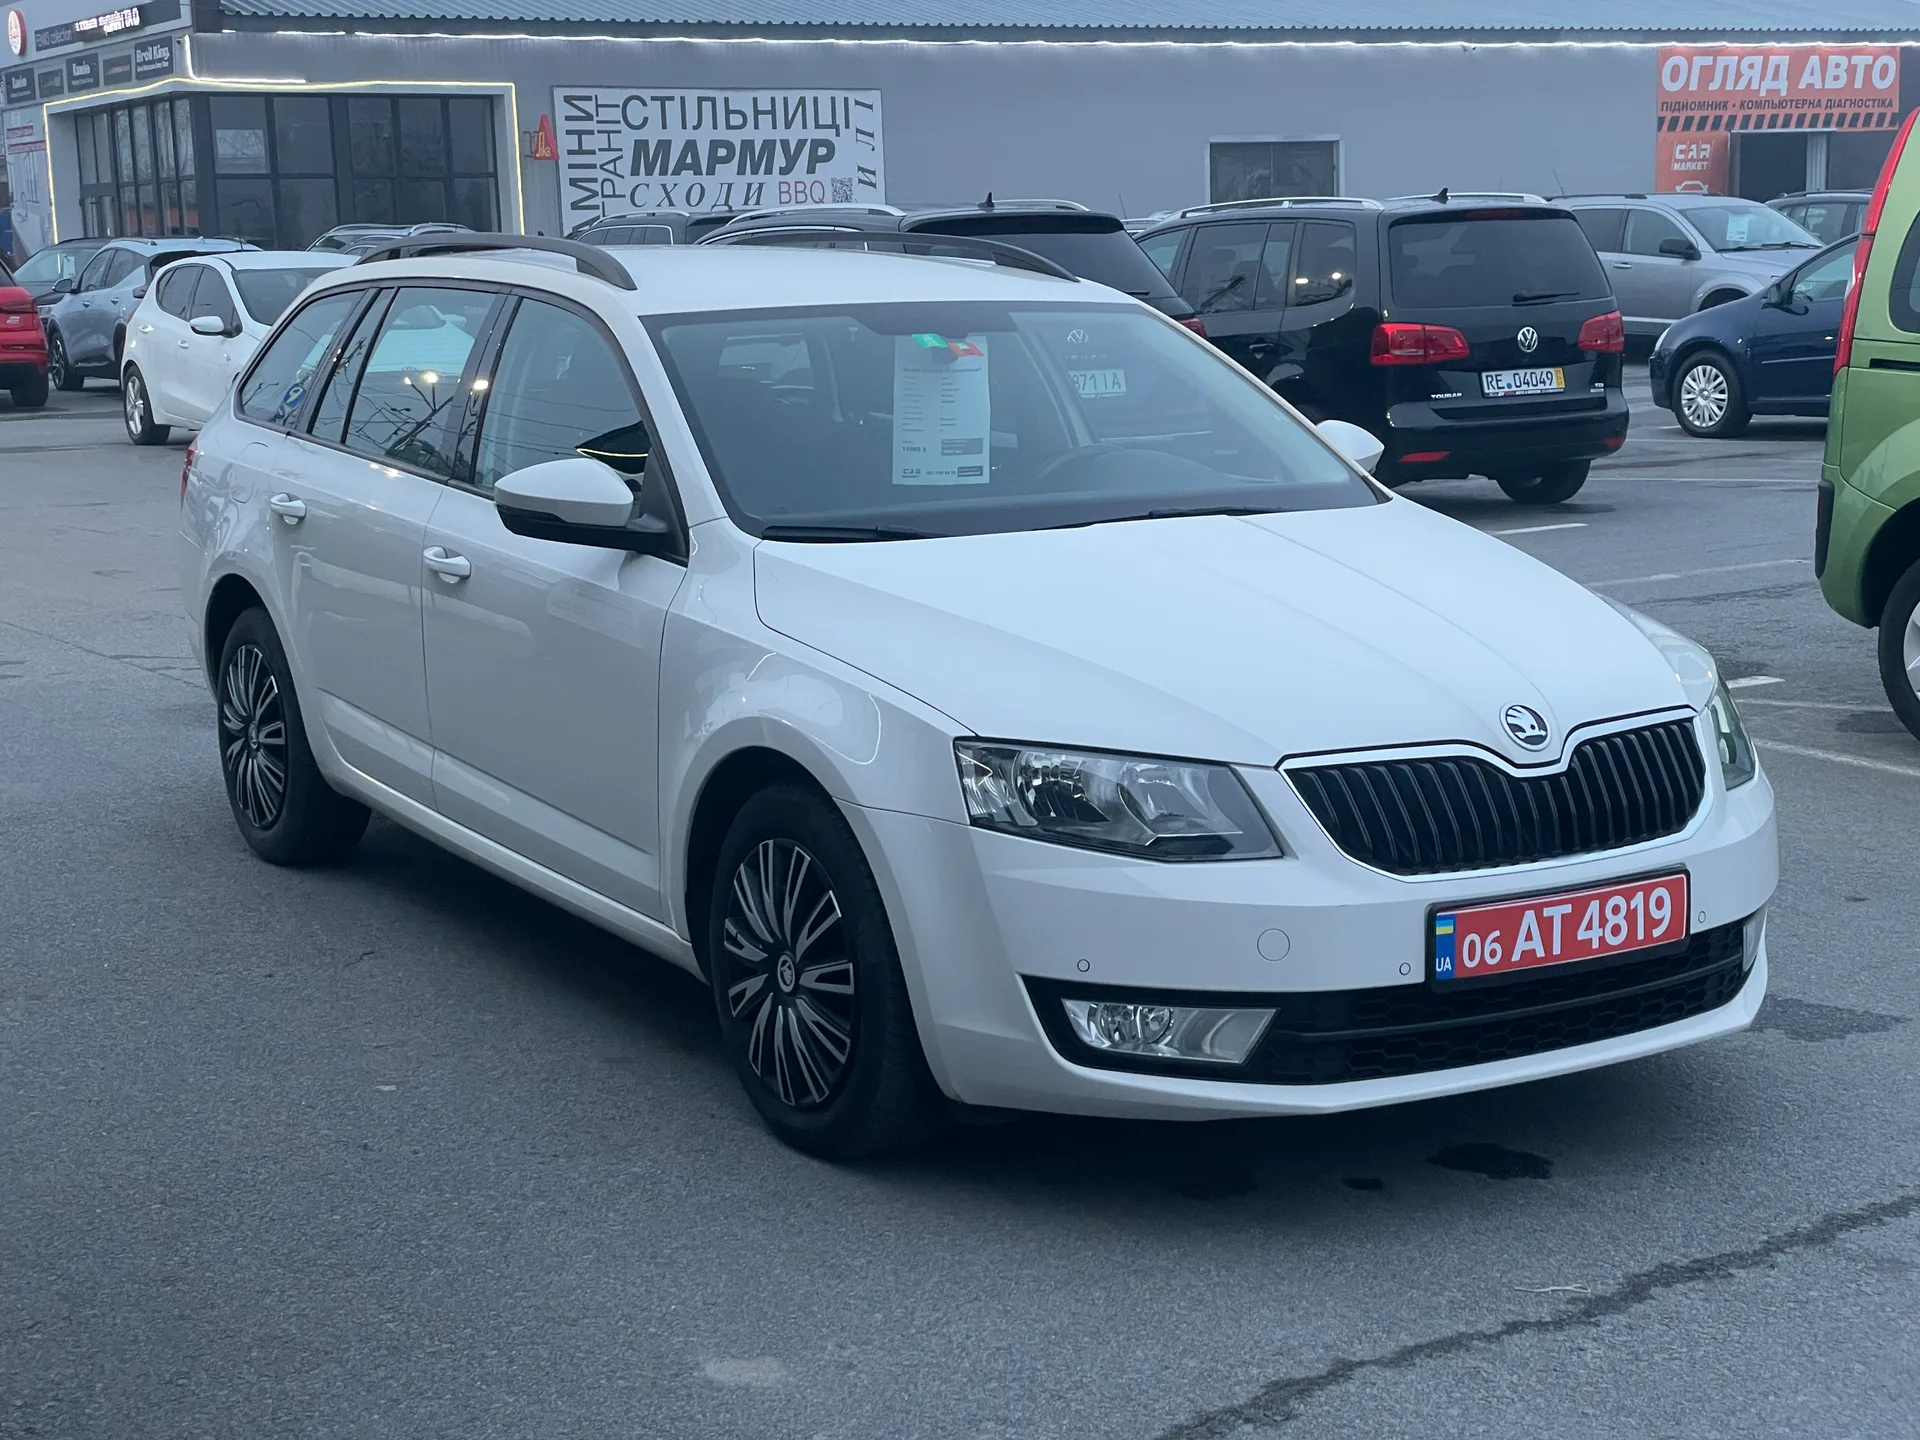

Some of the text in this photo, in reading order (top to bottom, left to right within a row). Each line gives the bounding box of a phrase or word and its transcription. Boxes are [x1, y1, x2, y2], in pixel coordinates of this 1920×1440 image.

[153, 44, 170, 60] King
[1661, 54, 1897, 97] ОГЛЯД АВТО
[621, 94, 851, 138] СТІЛЬНИЦІ
[1660, 99, 1729, 114] ПІДЙОМНИК
[629, 138, 837, 177] МАРМУР
[1674, 143, 1711, 160] CAR
[1673, 161, 1709, 171] MARKET
[629, 180, 826, 212] СХОДИ BBQ
[1485, 374, 1506, 391] RE
[1513, 370, 1554, 389] 04049
[1462, 886, 1672, 968] 06 AT 4819
[1435, 956, 1452, 973] UA
